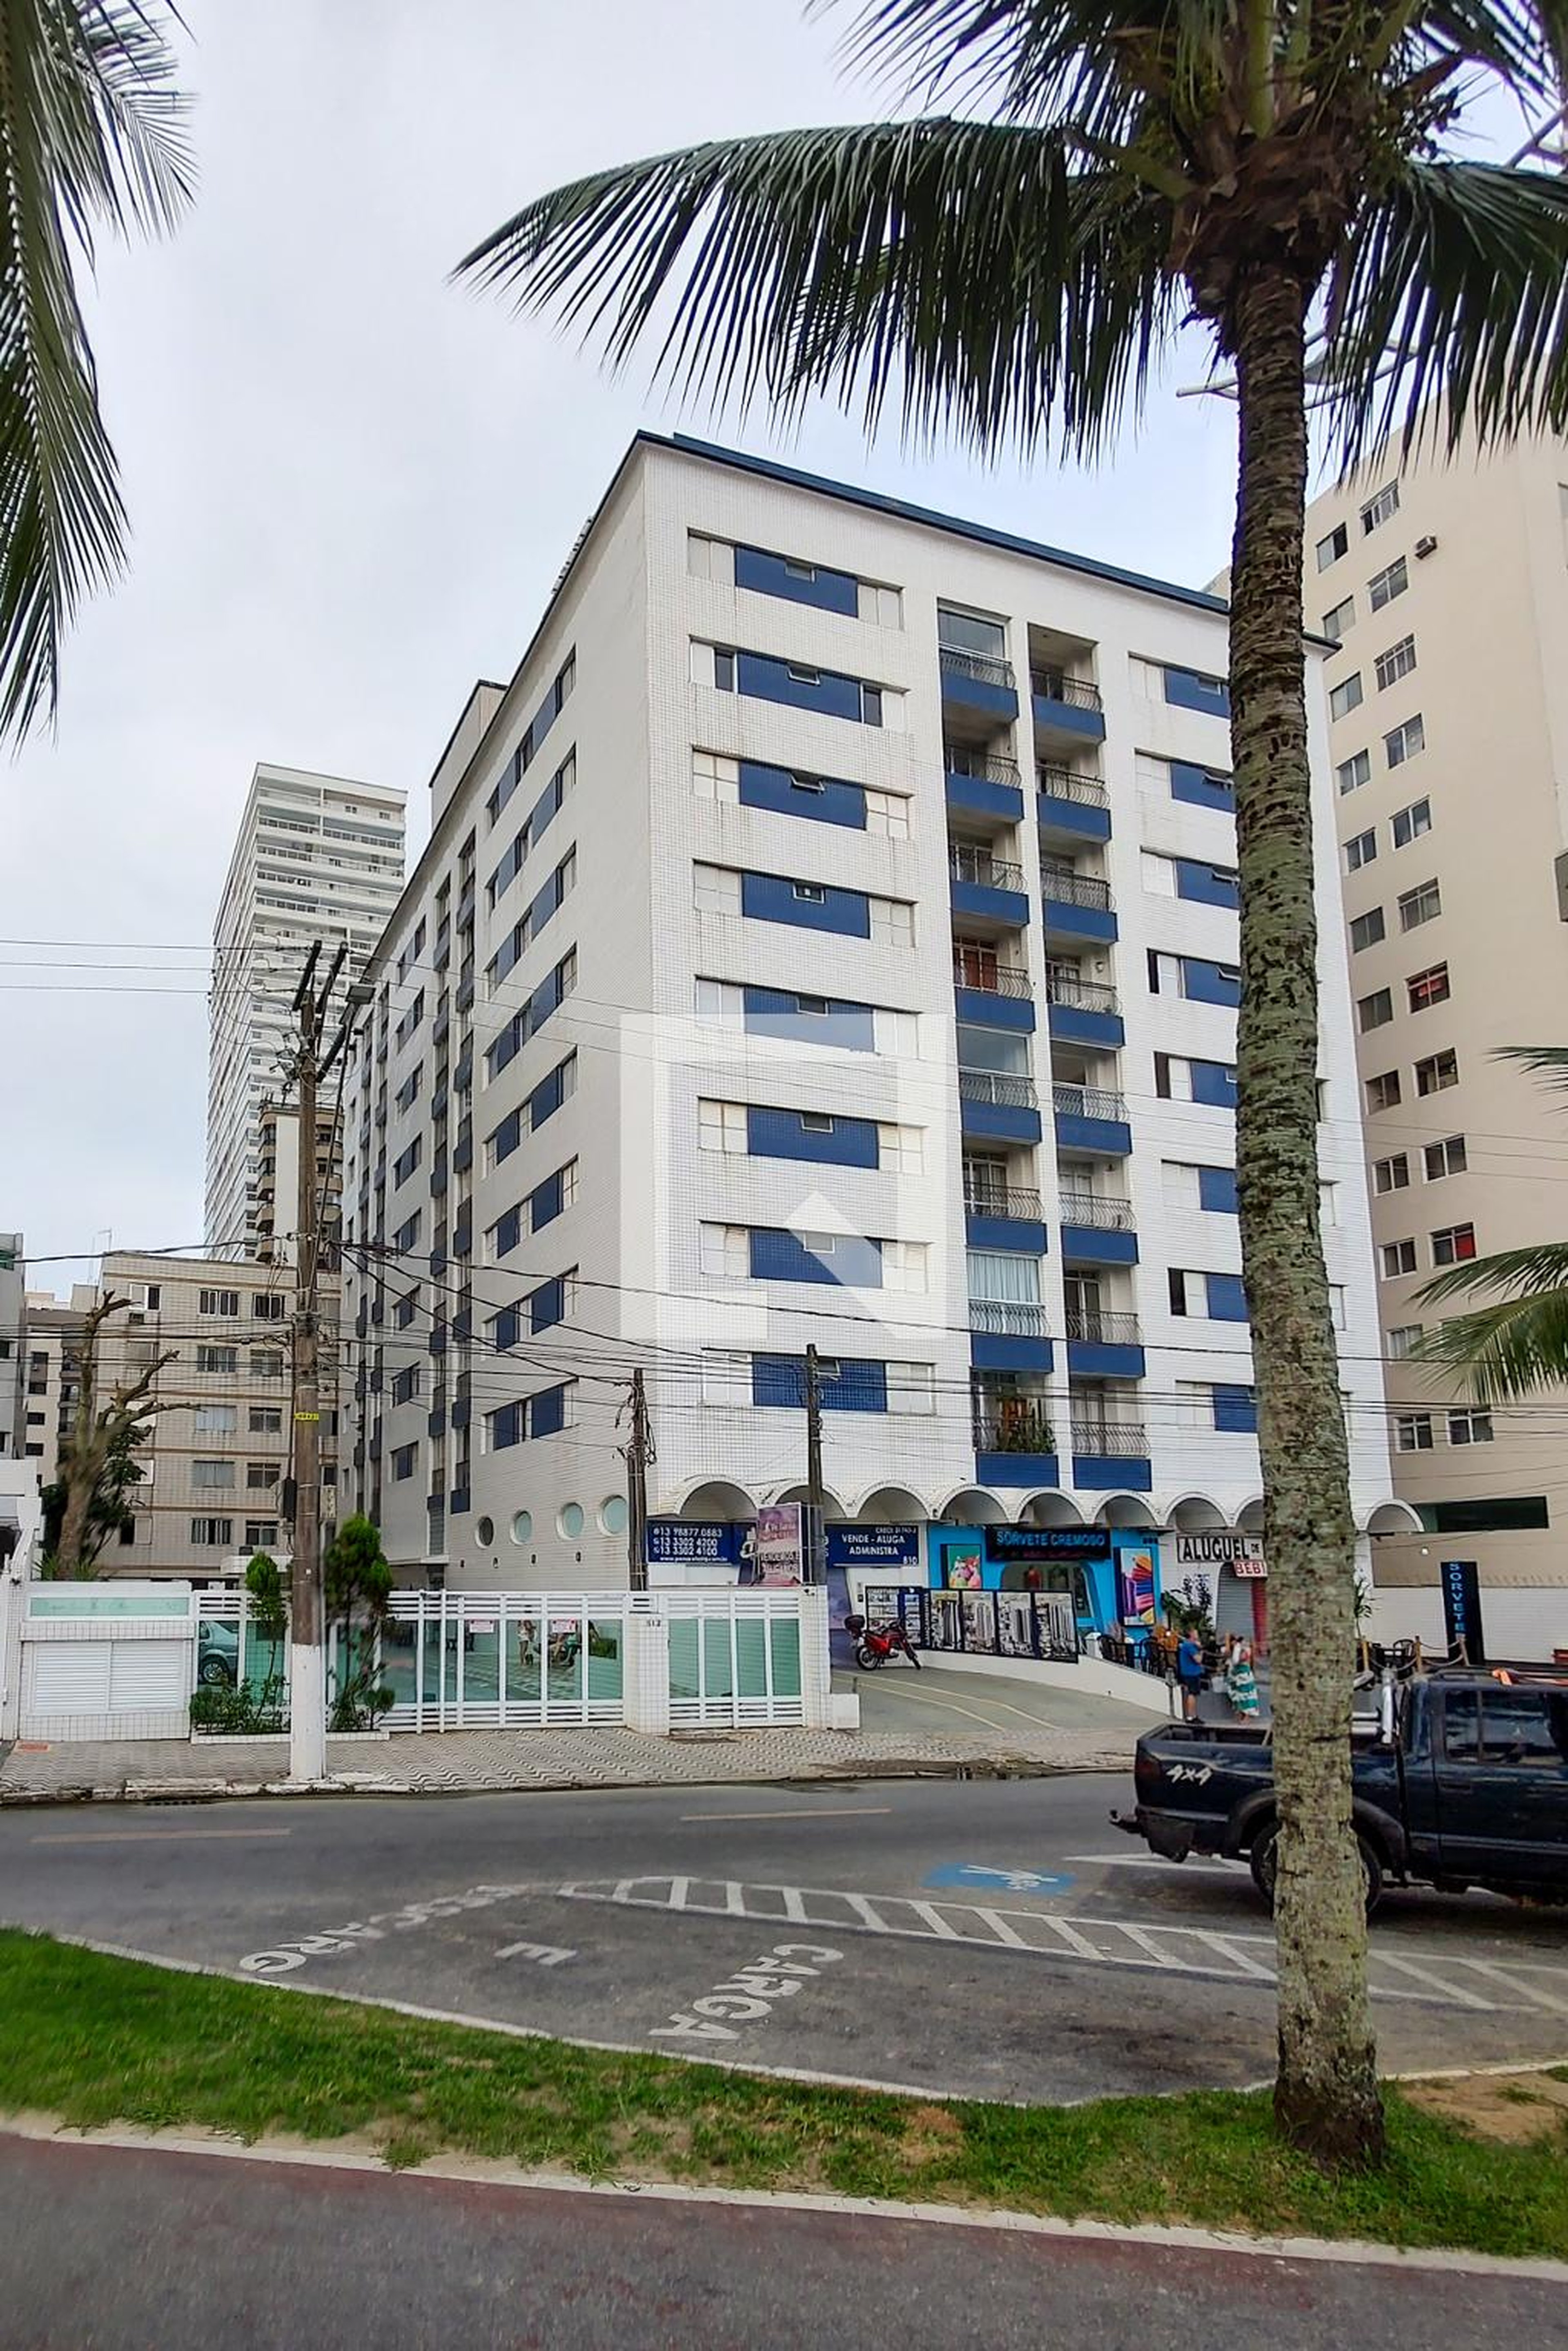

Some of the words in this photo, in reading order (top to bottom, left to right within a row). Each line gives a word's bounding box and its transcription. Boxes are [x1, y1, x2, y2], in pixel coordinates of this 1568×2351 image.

[842, 1534, 869, 1543] VENDE
[876, 1535, 905, 1544] ALUGA
[996, 1531, 1048, 1546] SORVETE
[1051, 1534, 1105, 1546] CREMOSO
[1183, 1537, 1250, 1560] ALUGUEL
[1251, 1544, 1260, 1553] DE
[849, 1546, 899, 1555] ADMINISTRA
[1449, 1563, 1466, 1631] SORVETE
[1166, 1764, 1212, 1786] 4x4
[648, 1943, 844, 2040] CARGA
